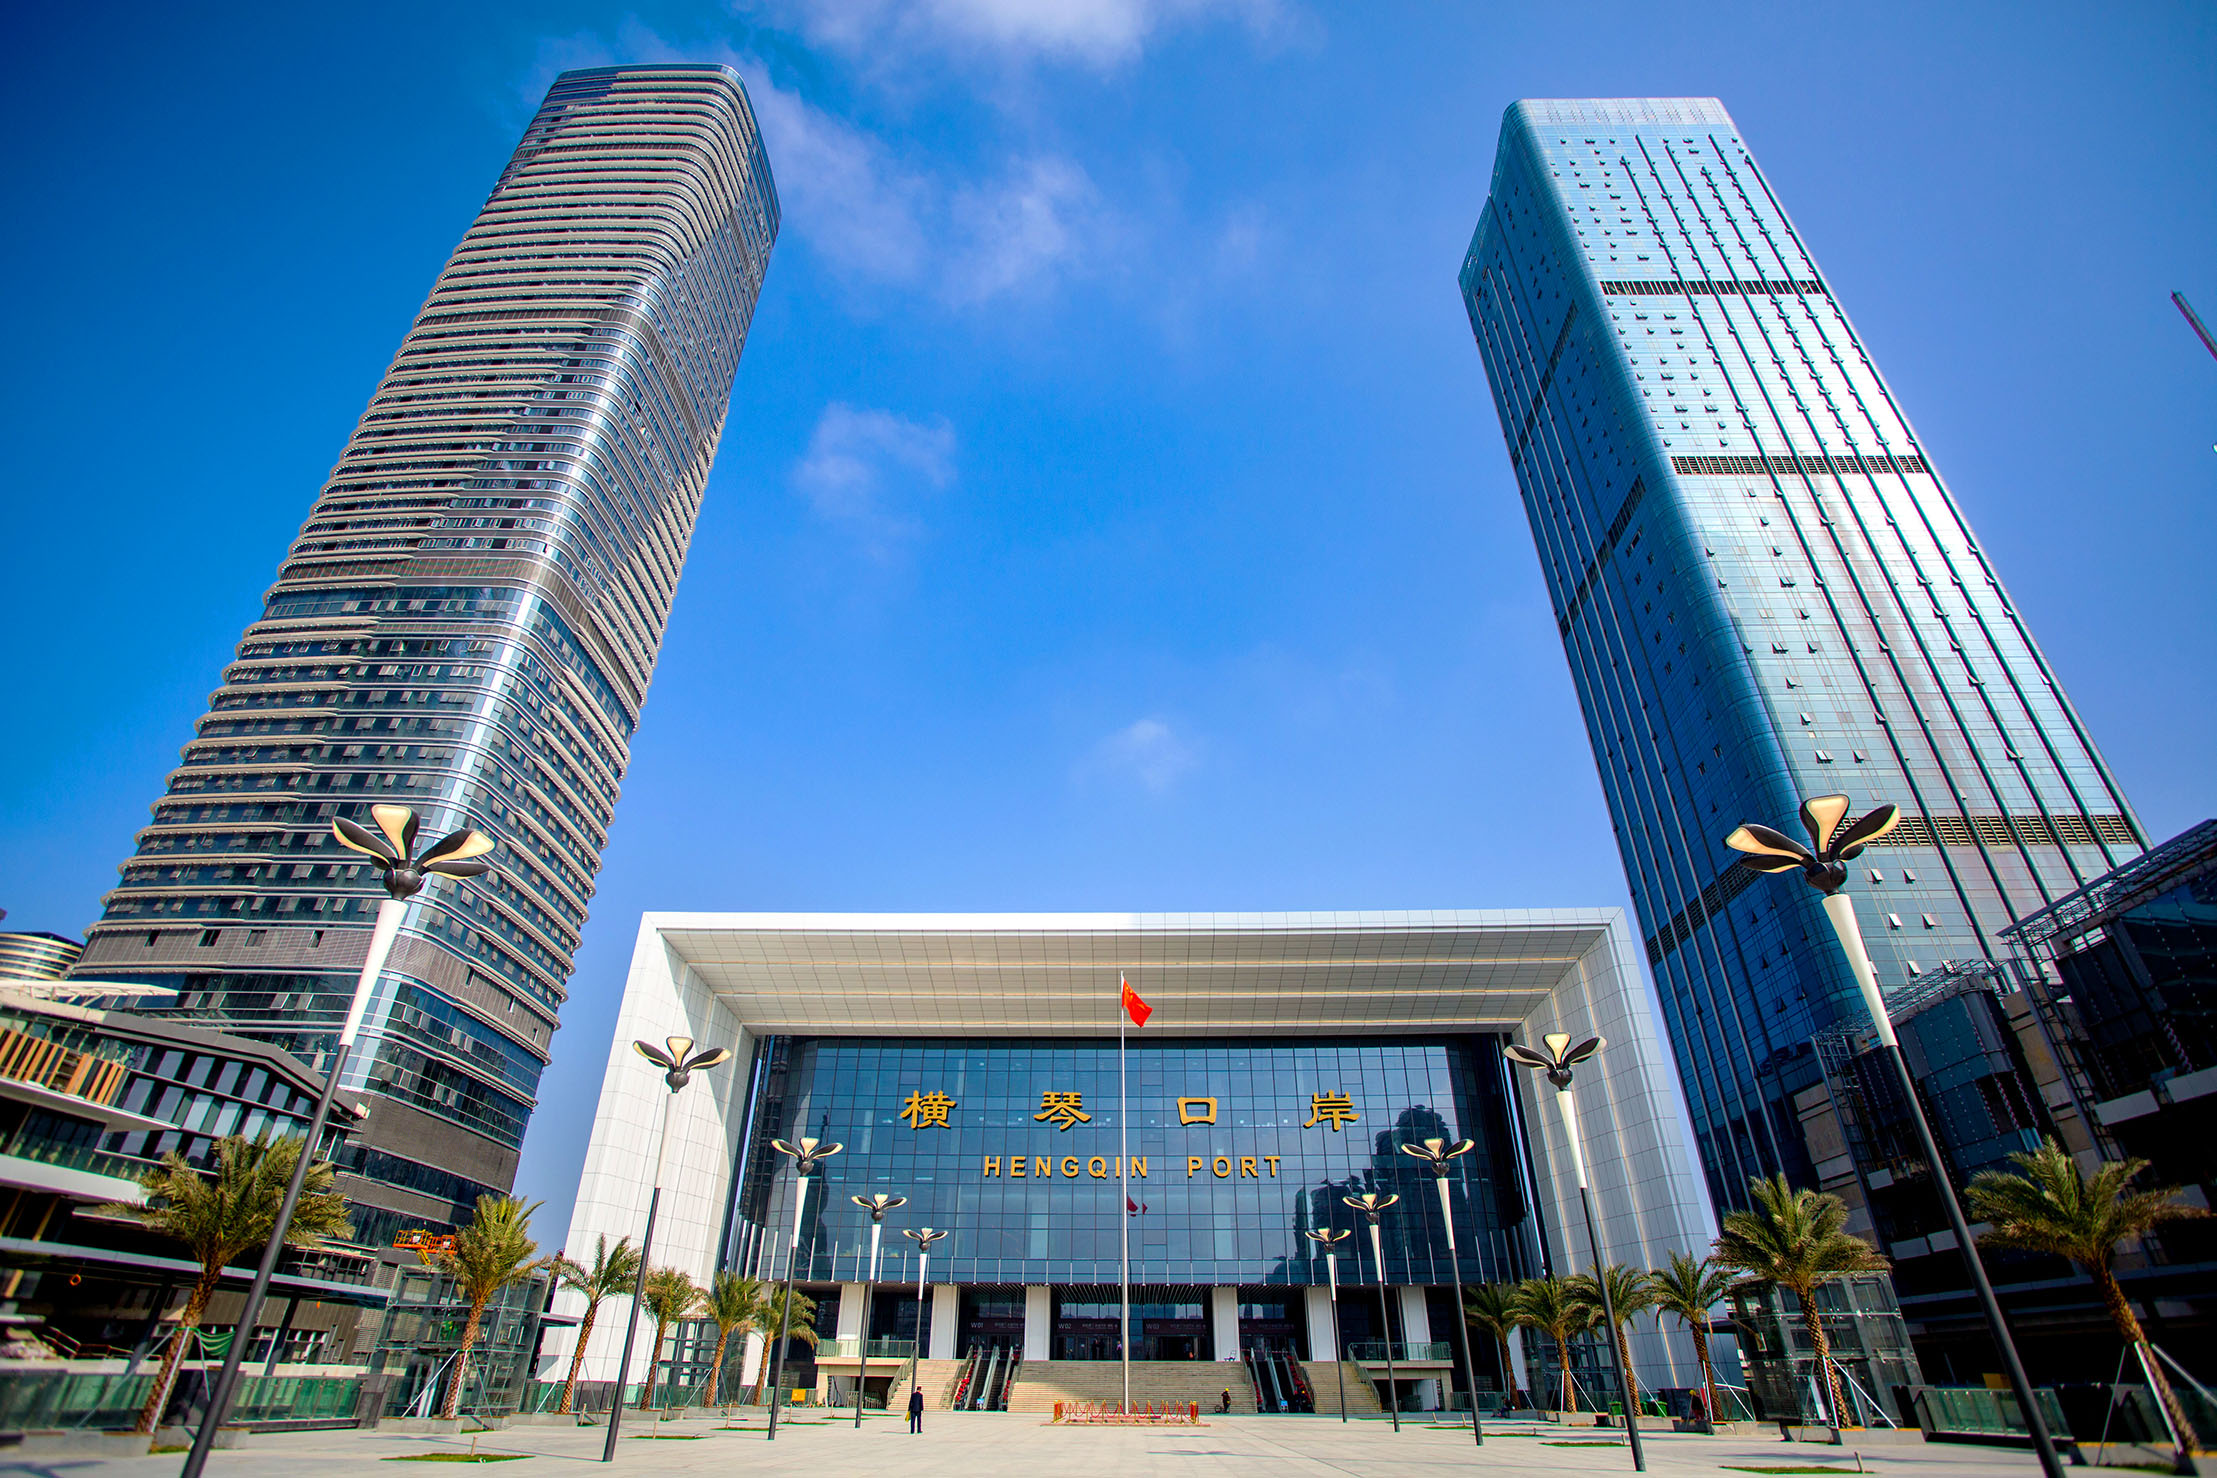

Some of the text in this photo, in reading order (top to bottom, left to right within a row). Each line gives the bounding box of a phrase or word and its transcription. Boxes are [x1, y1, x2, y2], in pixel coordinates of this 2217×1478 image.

[900, 1090, 1361, 1131] 横琴口岸
[984, 1156, 1281, 1179] HENGQIN PORT
